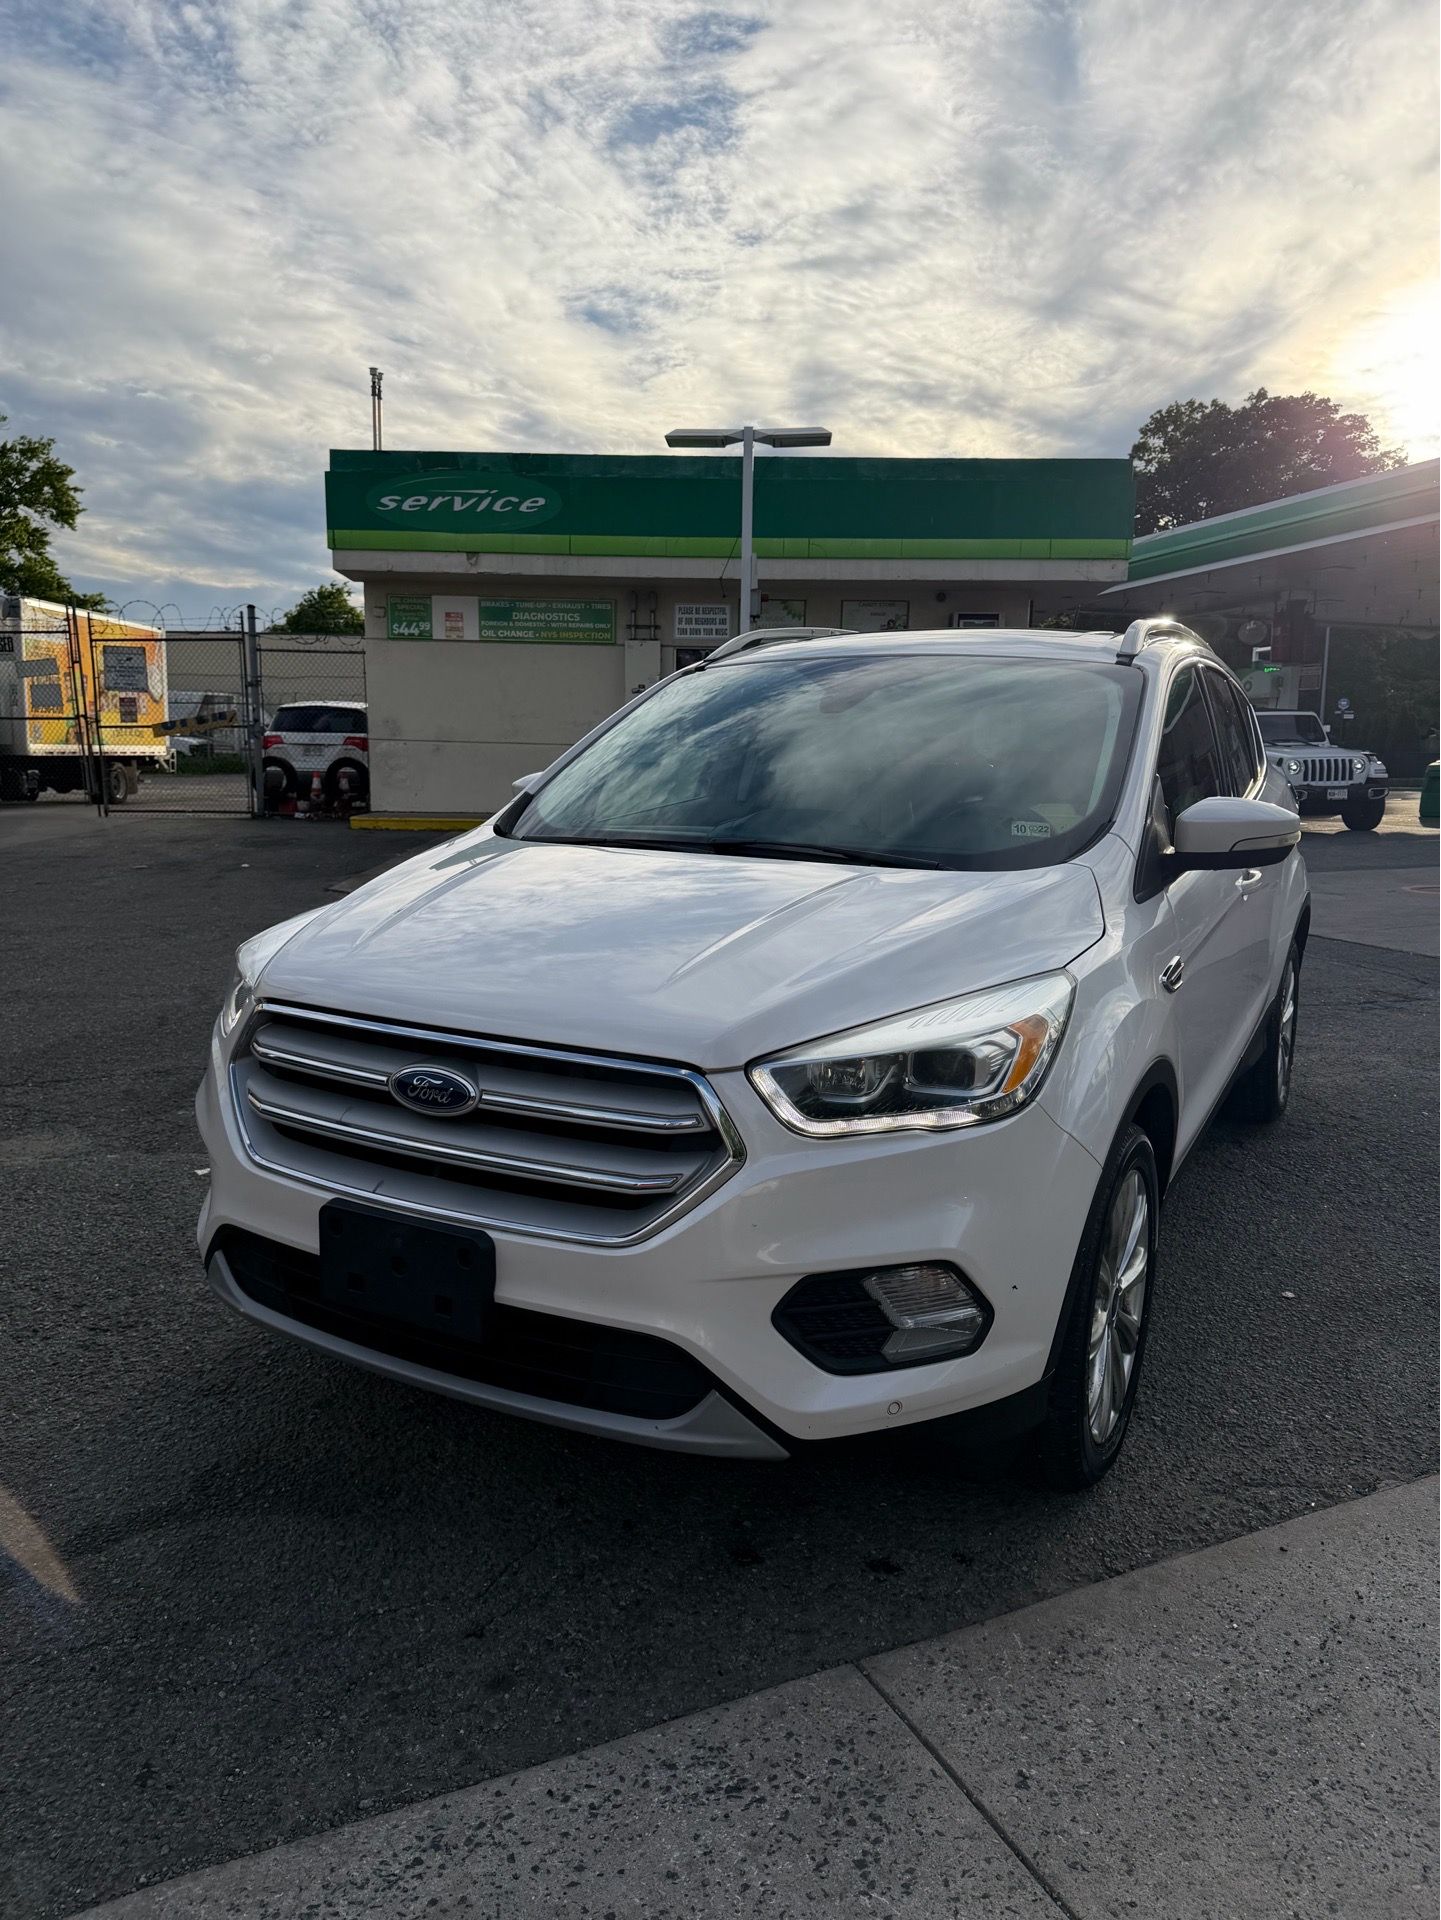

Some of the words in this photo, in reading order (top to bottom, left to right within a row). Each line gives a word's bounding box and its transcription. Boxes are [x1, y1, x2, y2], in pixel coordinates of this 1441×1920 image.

[376, 489, 546, 512] service
[678, 606, 694, 615] PLEASE
[702, 607, 727, 615] RESPECTFUL
[512, 611, 581, 621] DIAGNOSTICS
[718, 617, 727, 625] AND
[481, 629, 497, 637] OIL
[498, 630, 535, 638] CHANGE
[677, 627, 688, 636] TURN
[689, 627, 701, 636] DOWN
[703, 628, 713, 636] YOUR
[715, 628, 728, 636] MUSIC
[1014, 824, 1027, 834] 10
[407, 1075, 454, 1104] Ford
